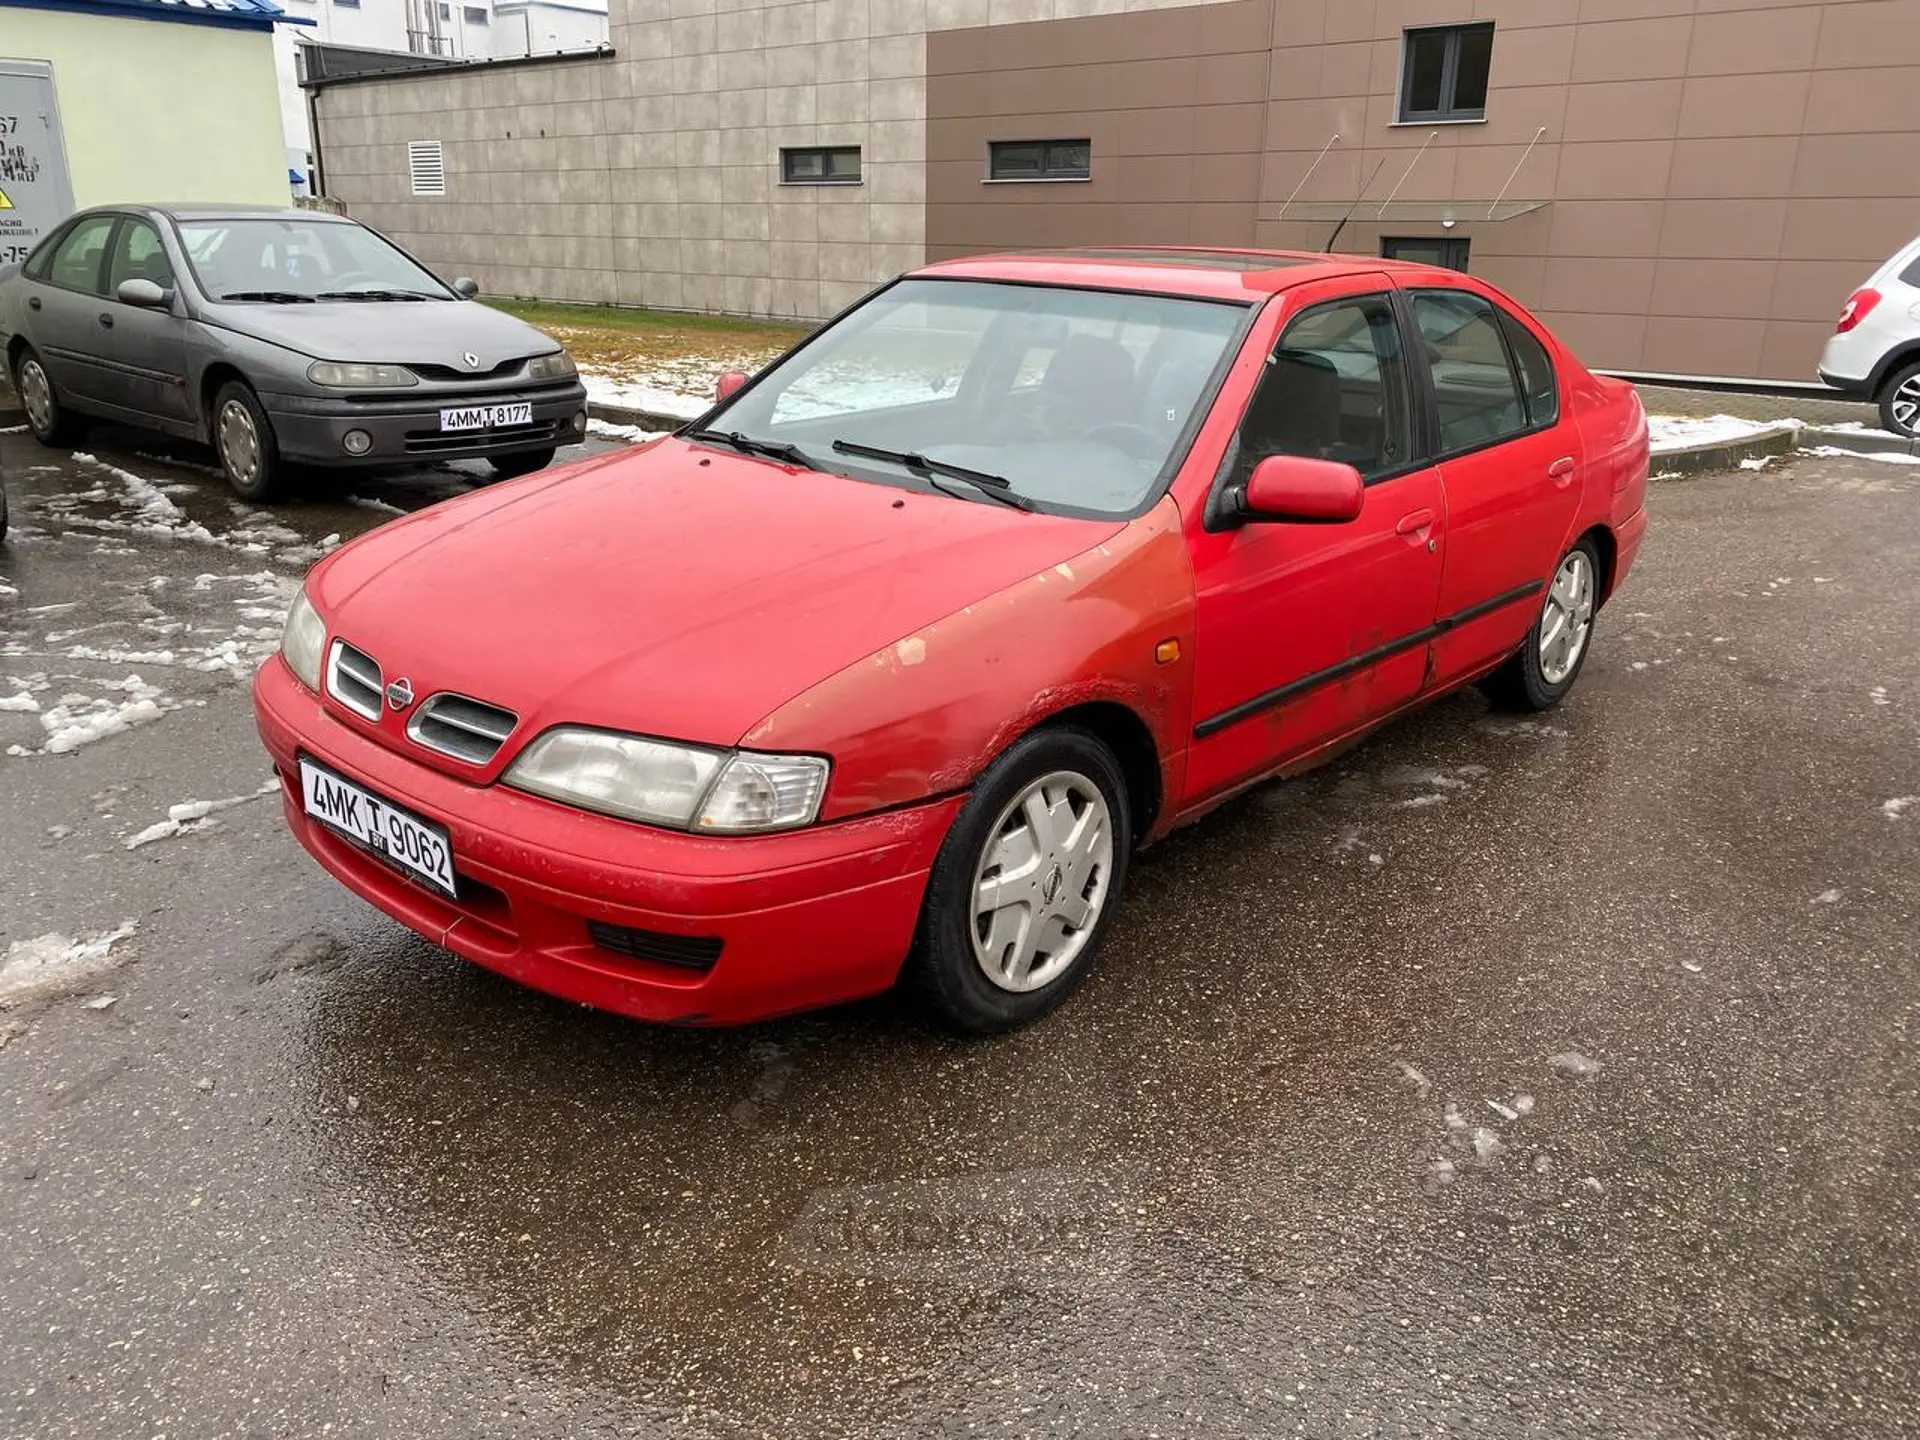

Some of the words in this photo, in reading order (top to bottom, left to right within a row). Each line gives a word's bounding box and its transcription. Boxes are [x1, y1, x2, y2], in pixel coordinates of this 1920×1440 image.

[0, 246, 28, 263] -75
[447, 410, 481, 427] 4MM
[497, 405, 529, 423] 8177
[313, 774, 363, 833] 4MK
[366, 797, 381, 832] T
[389, 815, 450, 885] 9062
